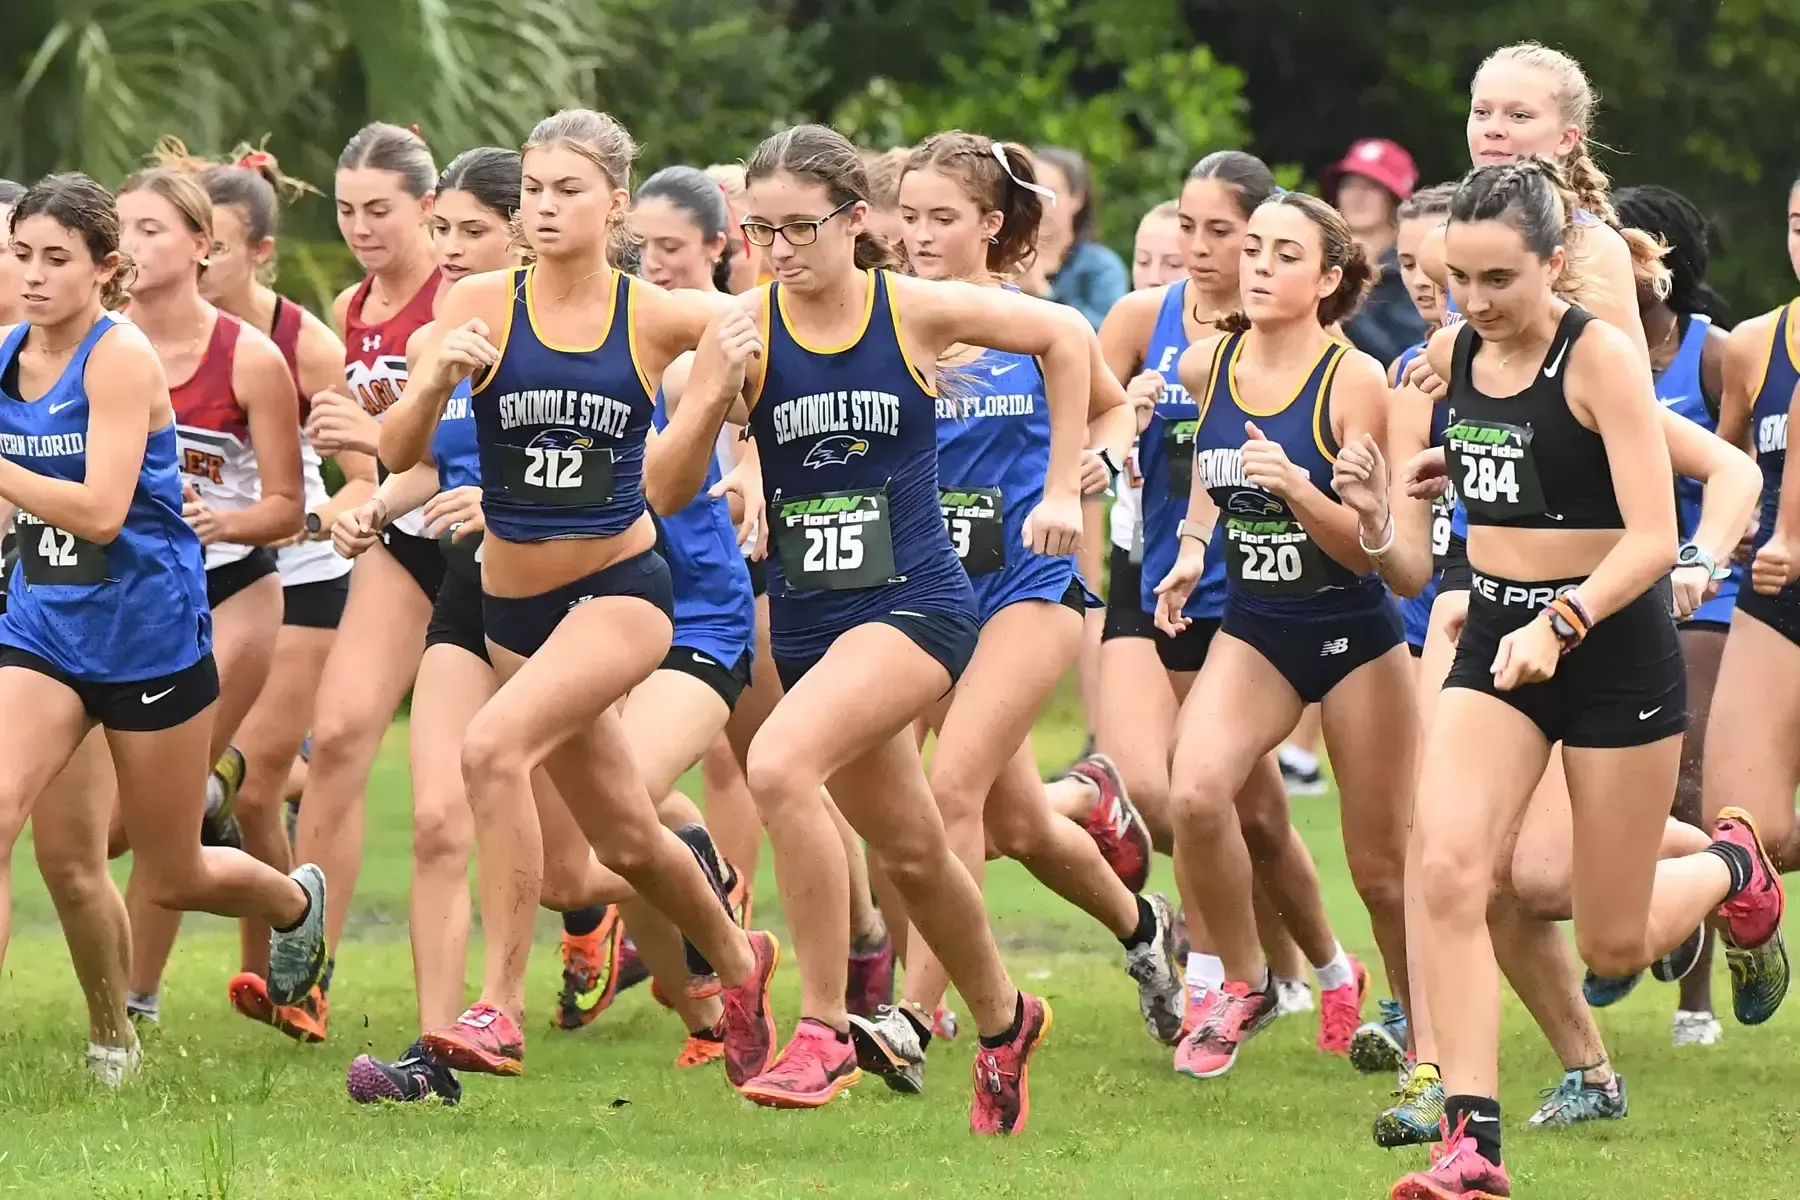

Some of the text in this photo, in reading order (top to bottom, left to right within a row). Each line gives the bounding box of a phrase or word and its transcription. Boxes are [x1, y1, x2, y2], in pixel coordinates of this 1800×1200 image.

[499, 390, 632, 439] SEMINOLE STATE
[773, 390, 900, 445] SEMINOLE STATE
[964, 394, 1034, 418] FLORIDA
[27, 432, 84, 457] FLORID
[1447, 425, 1510, 444] RUN
[1450, 438, 1524, 459] Florida
[524, 447, 583, 488] 212
[1461, 455, 1519, 503] 284
[781, 495, 863, 517] RUN
[786, 509, 881, 528] Florida
[38, 526, 78, 567] 42
[803, 524, 864, 572] 215
[1228, 528, 1308, 545] Florida
[1239, 544, 1303, 581] 220
